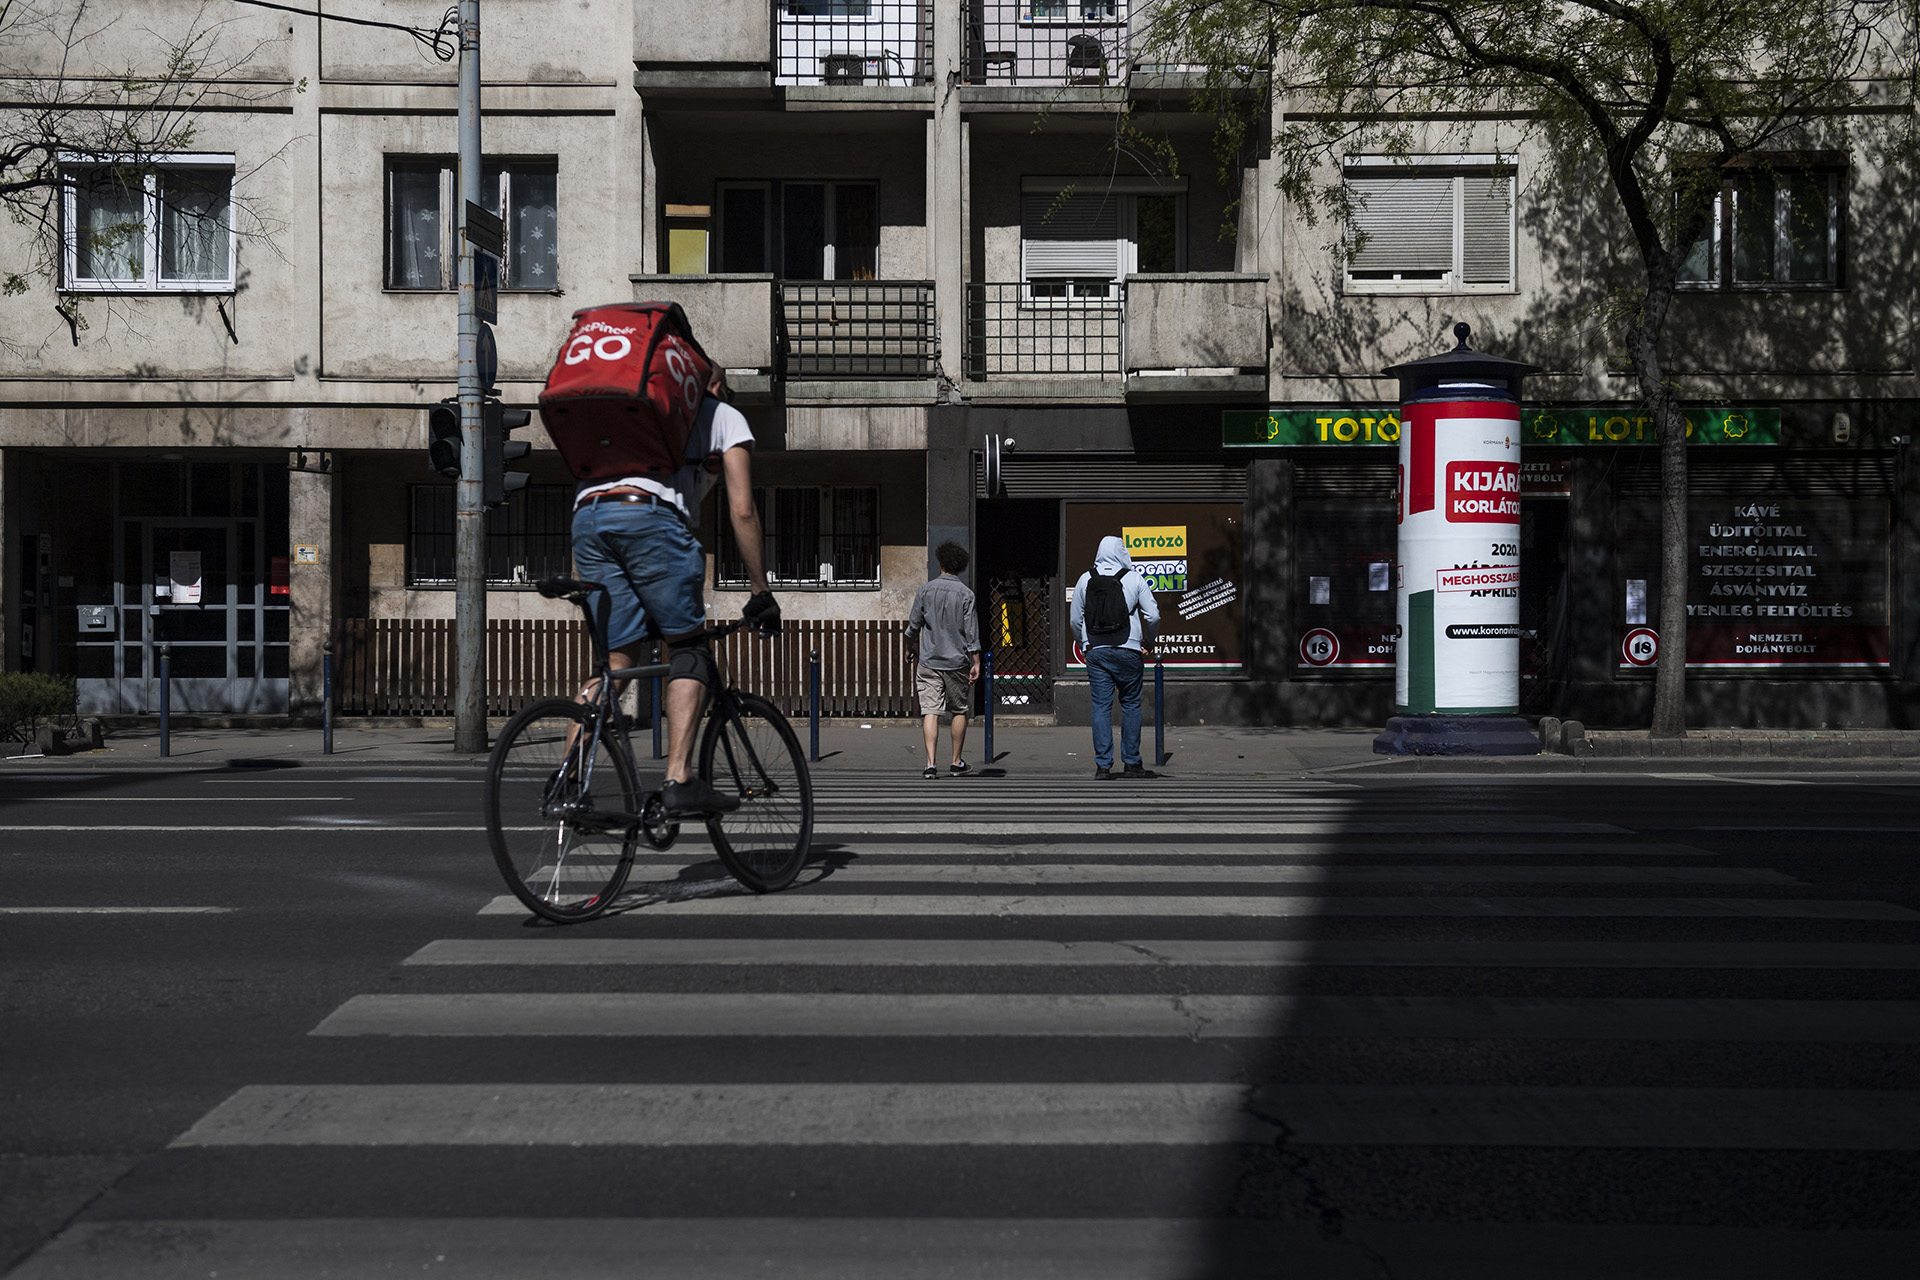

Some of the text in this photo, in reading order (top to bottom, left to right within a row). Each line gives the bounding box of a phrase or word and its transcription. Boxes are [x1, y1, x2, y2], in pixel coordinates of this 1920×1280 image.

[565, 335, 631, 365] GO
[1316, 413, 1400, 441] TOTÓ
[1735, 503, 1780, 517] KÁVÉ
[1492, 543, 1518, 556] 2020.
[1700, 545, 1817, 557] ENERGIAITAL
[1702, 565, 1816, 577] SZESZESITAL
[1144, 574, 1186, 590] ONT
[1709, 581, 1808, 597] ÁSVÁNYVÍZ
[1686, 602, 1853, 617] YENLEG FELTÖLTÉS
[1749, 634, 1803, 642] NEMZETI
[1150, 644, 1216, 654] HÁNYBOLT
[1311, 642, 1329, 655] 18
[1634, 641, 1652, 654] 18
[1736, 644, 1816, 653] DOHÁNYBOLT
